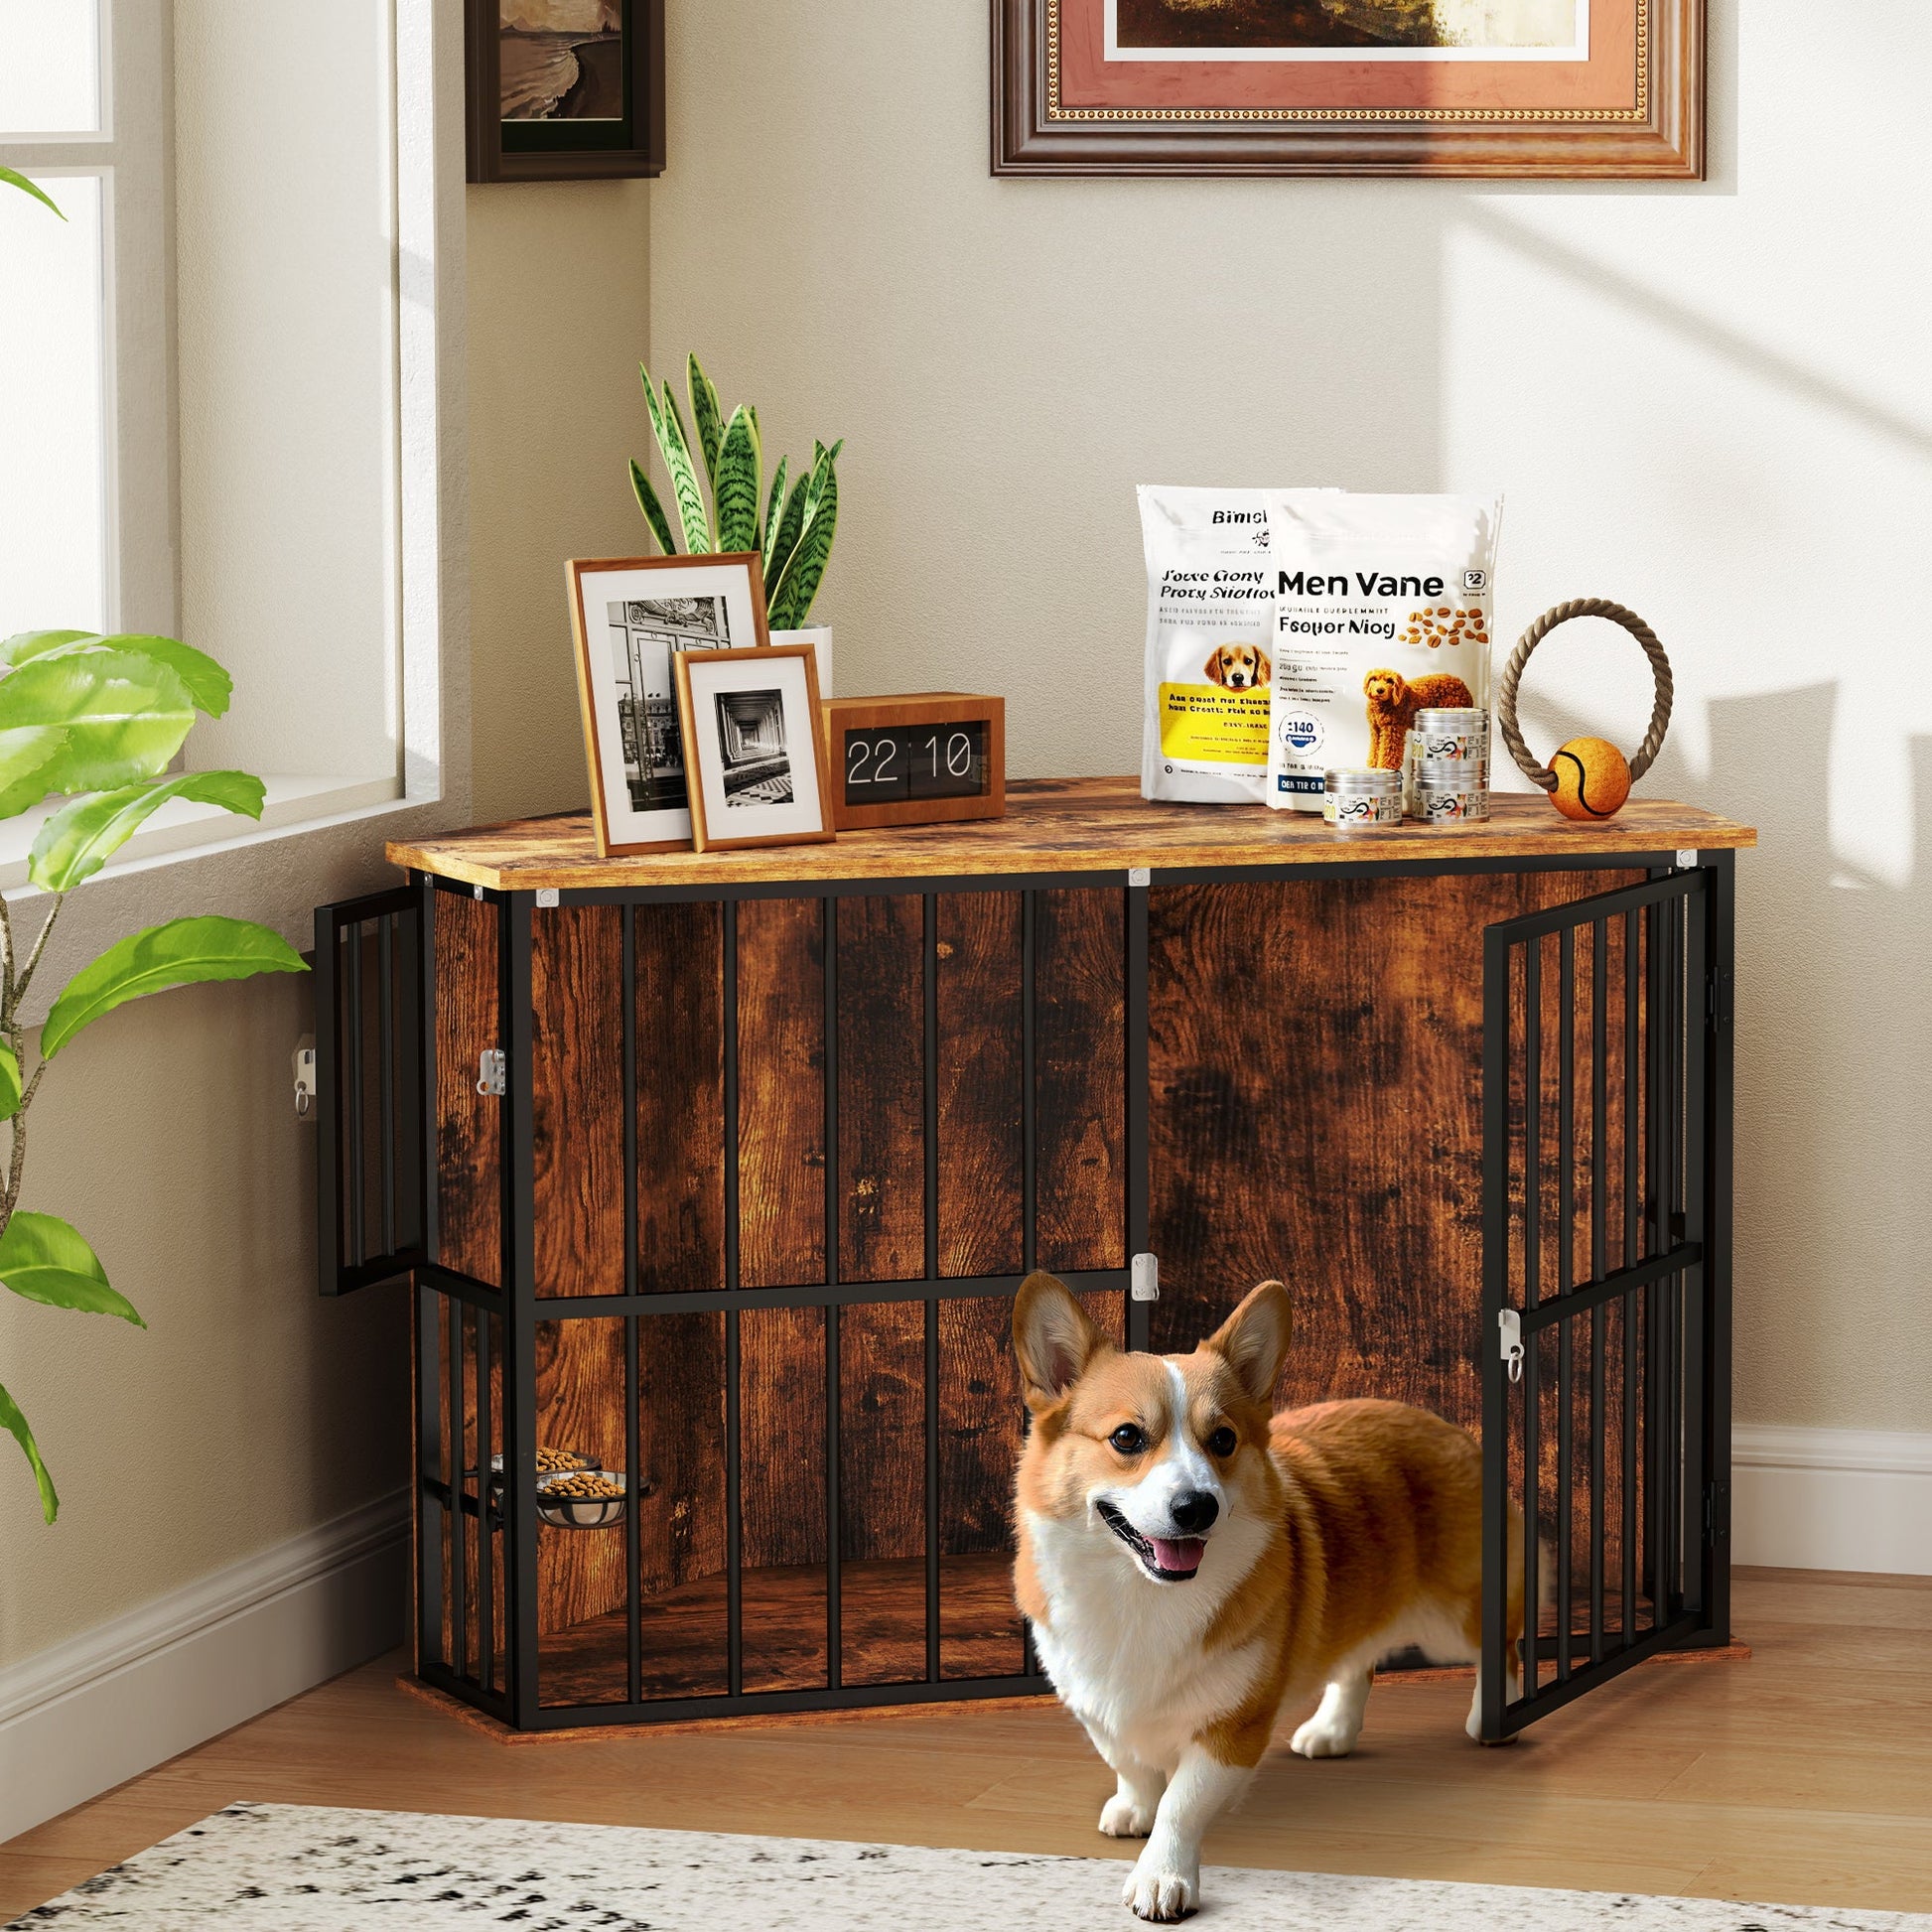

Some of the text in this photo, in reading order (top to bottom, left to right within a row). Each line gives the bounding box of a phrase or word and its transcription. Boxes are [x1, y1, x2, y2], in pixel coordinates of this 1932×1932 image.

[1278, 571, 1445, 598] Men Vane
[848, 732, 971, 784] 22 10
